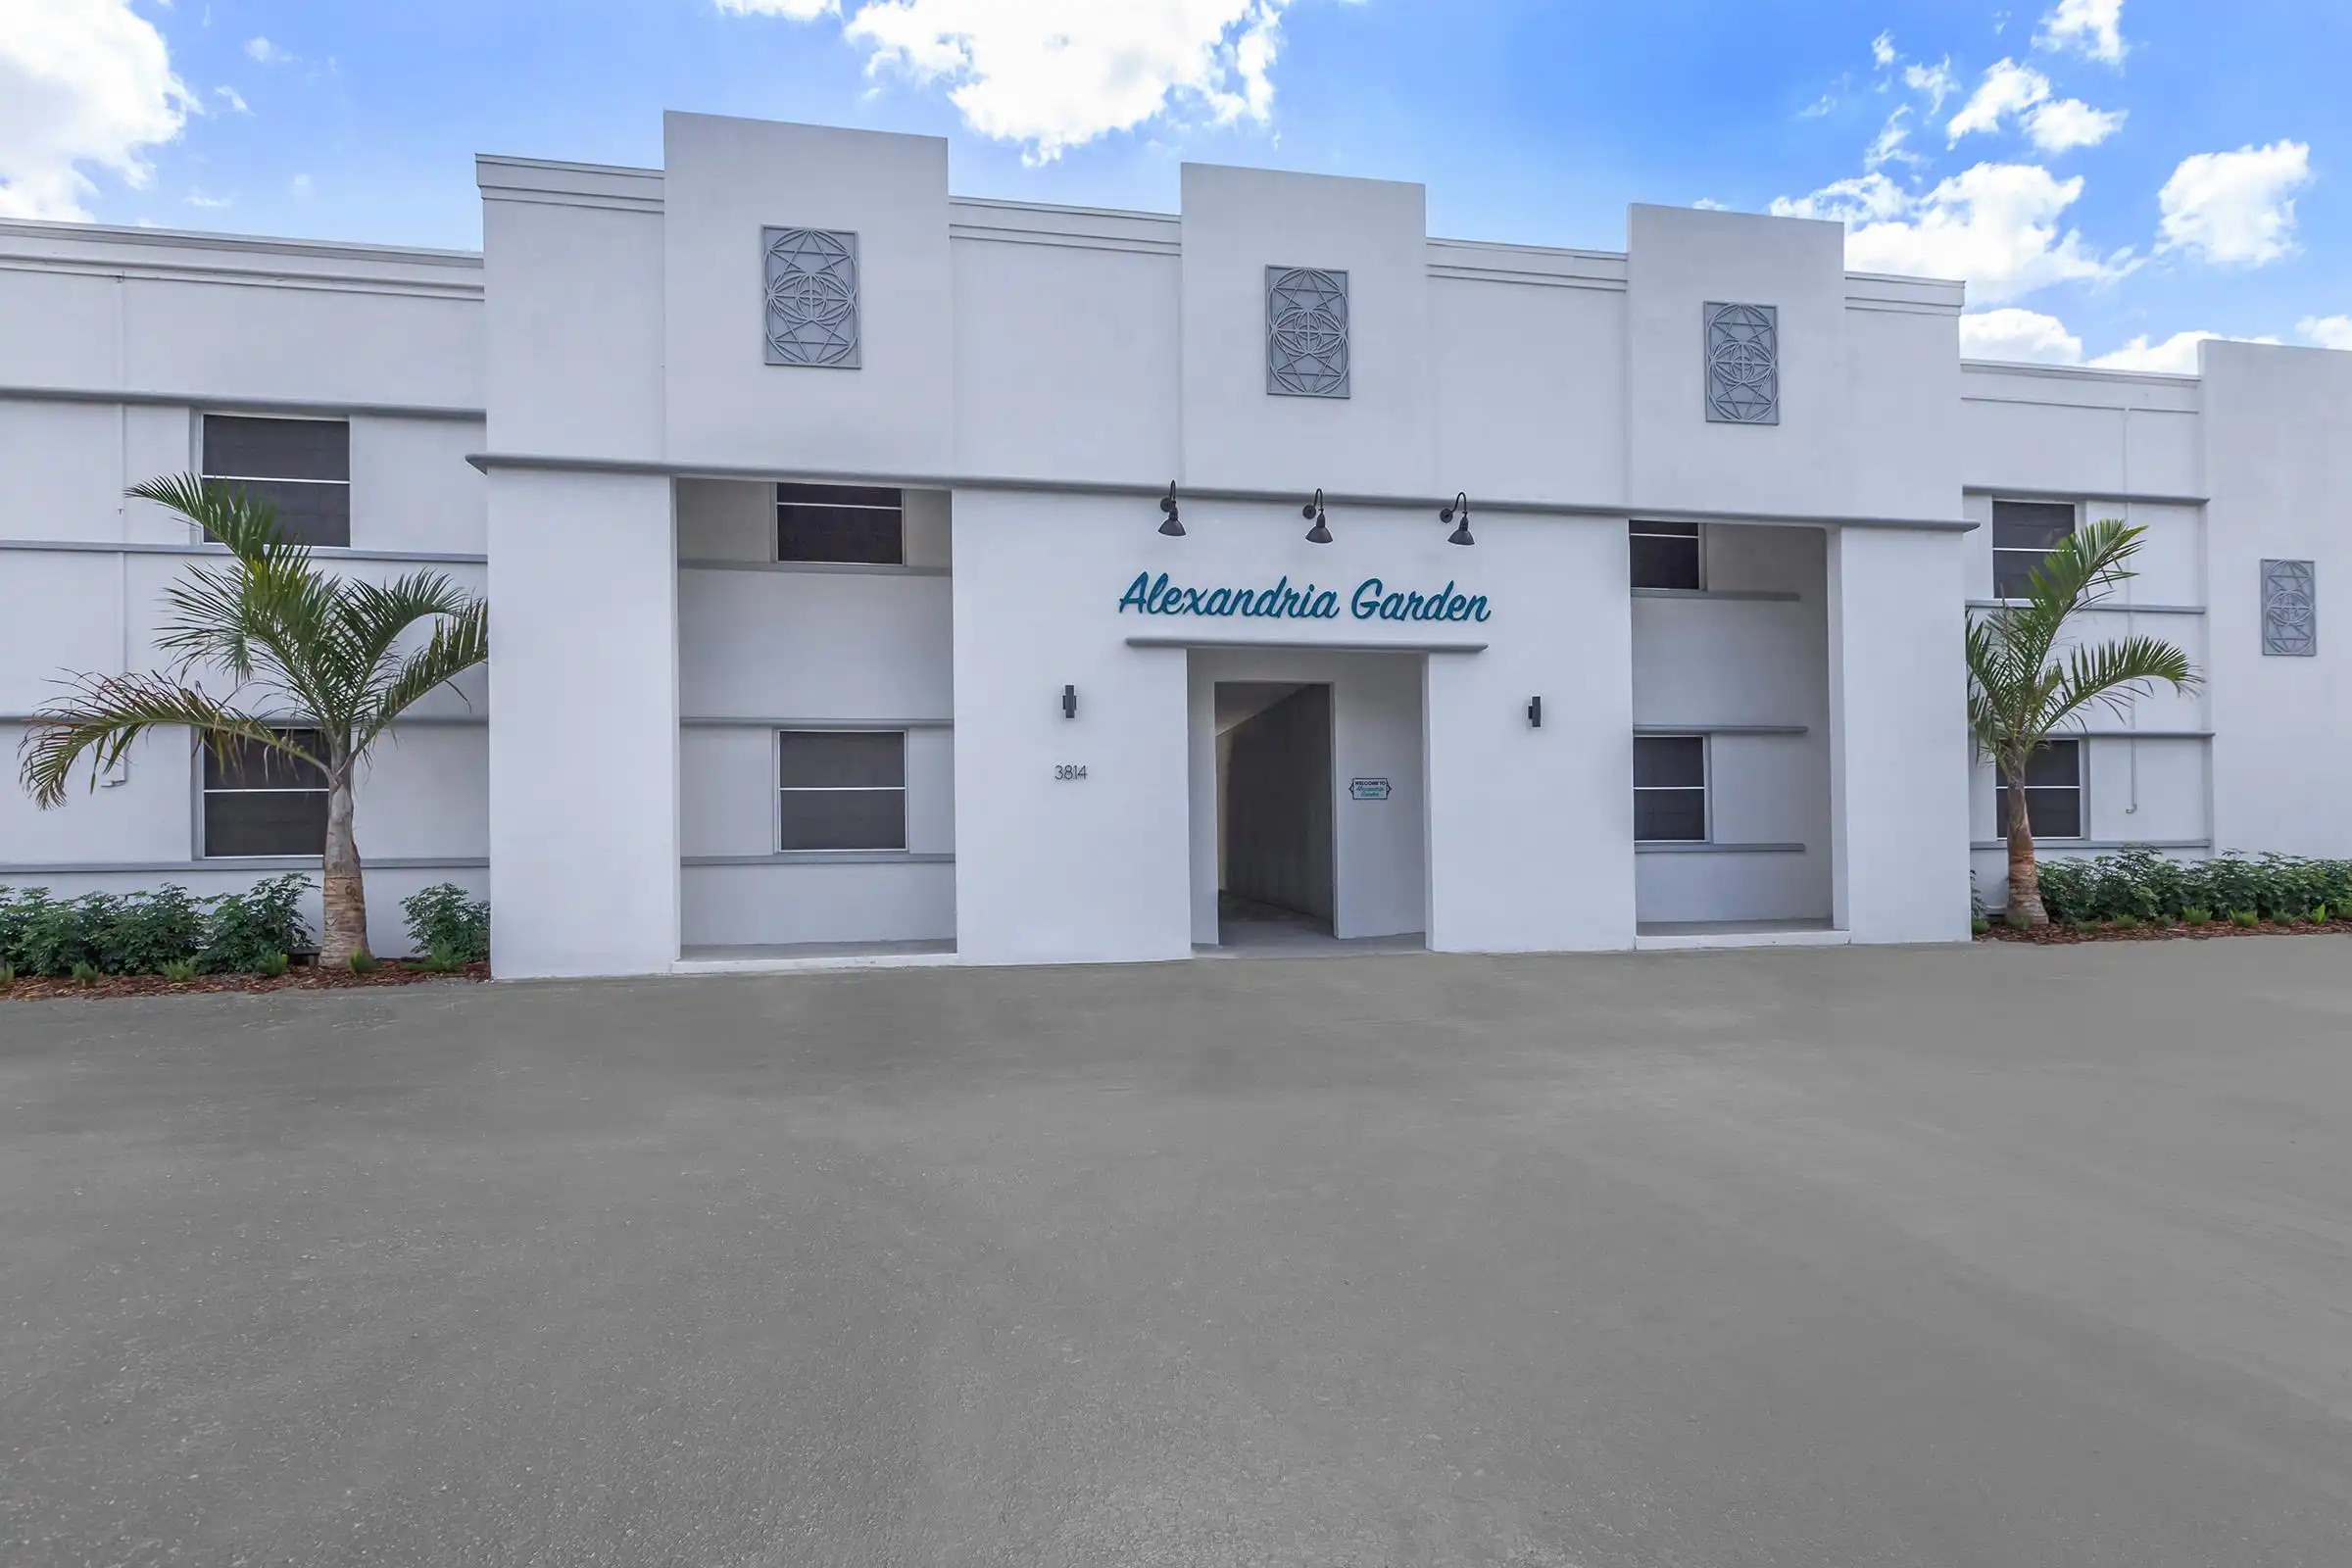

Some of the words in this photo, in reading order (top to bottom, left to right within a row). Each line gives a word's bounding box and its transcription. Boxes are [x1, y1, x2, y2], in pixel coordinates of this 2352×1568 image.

[1118, 570, 1341, 619] Alexandria
[1350, 577, 1492, 622] Garden
[1054, 764, 1088, 780] 3814
